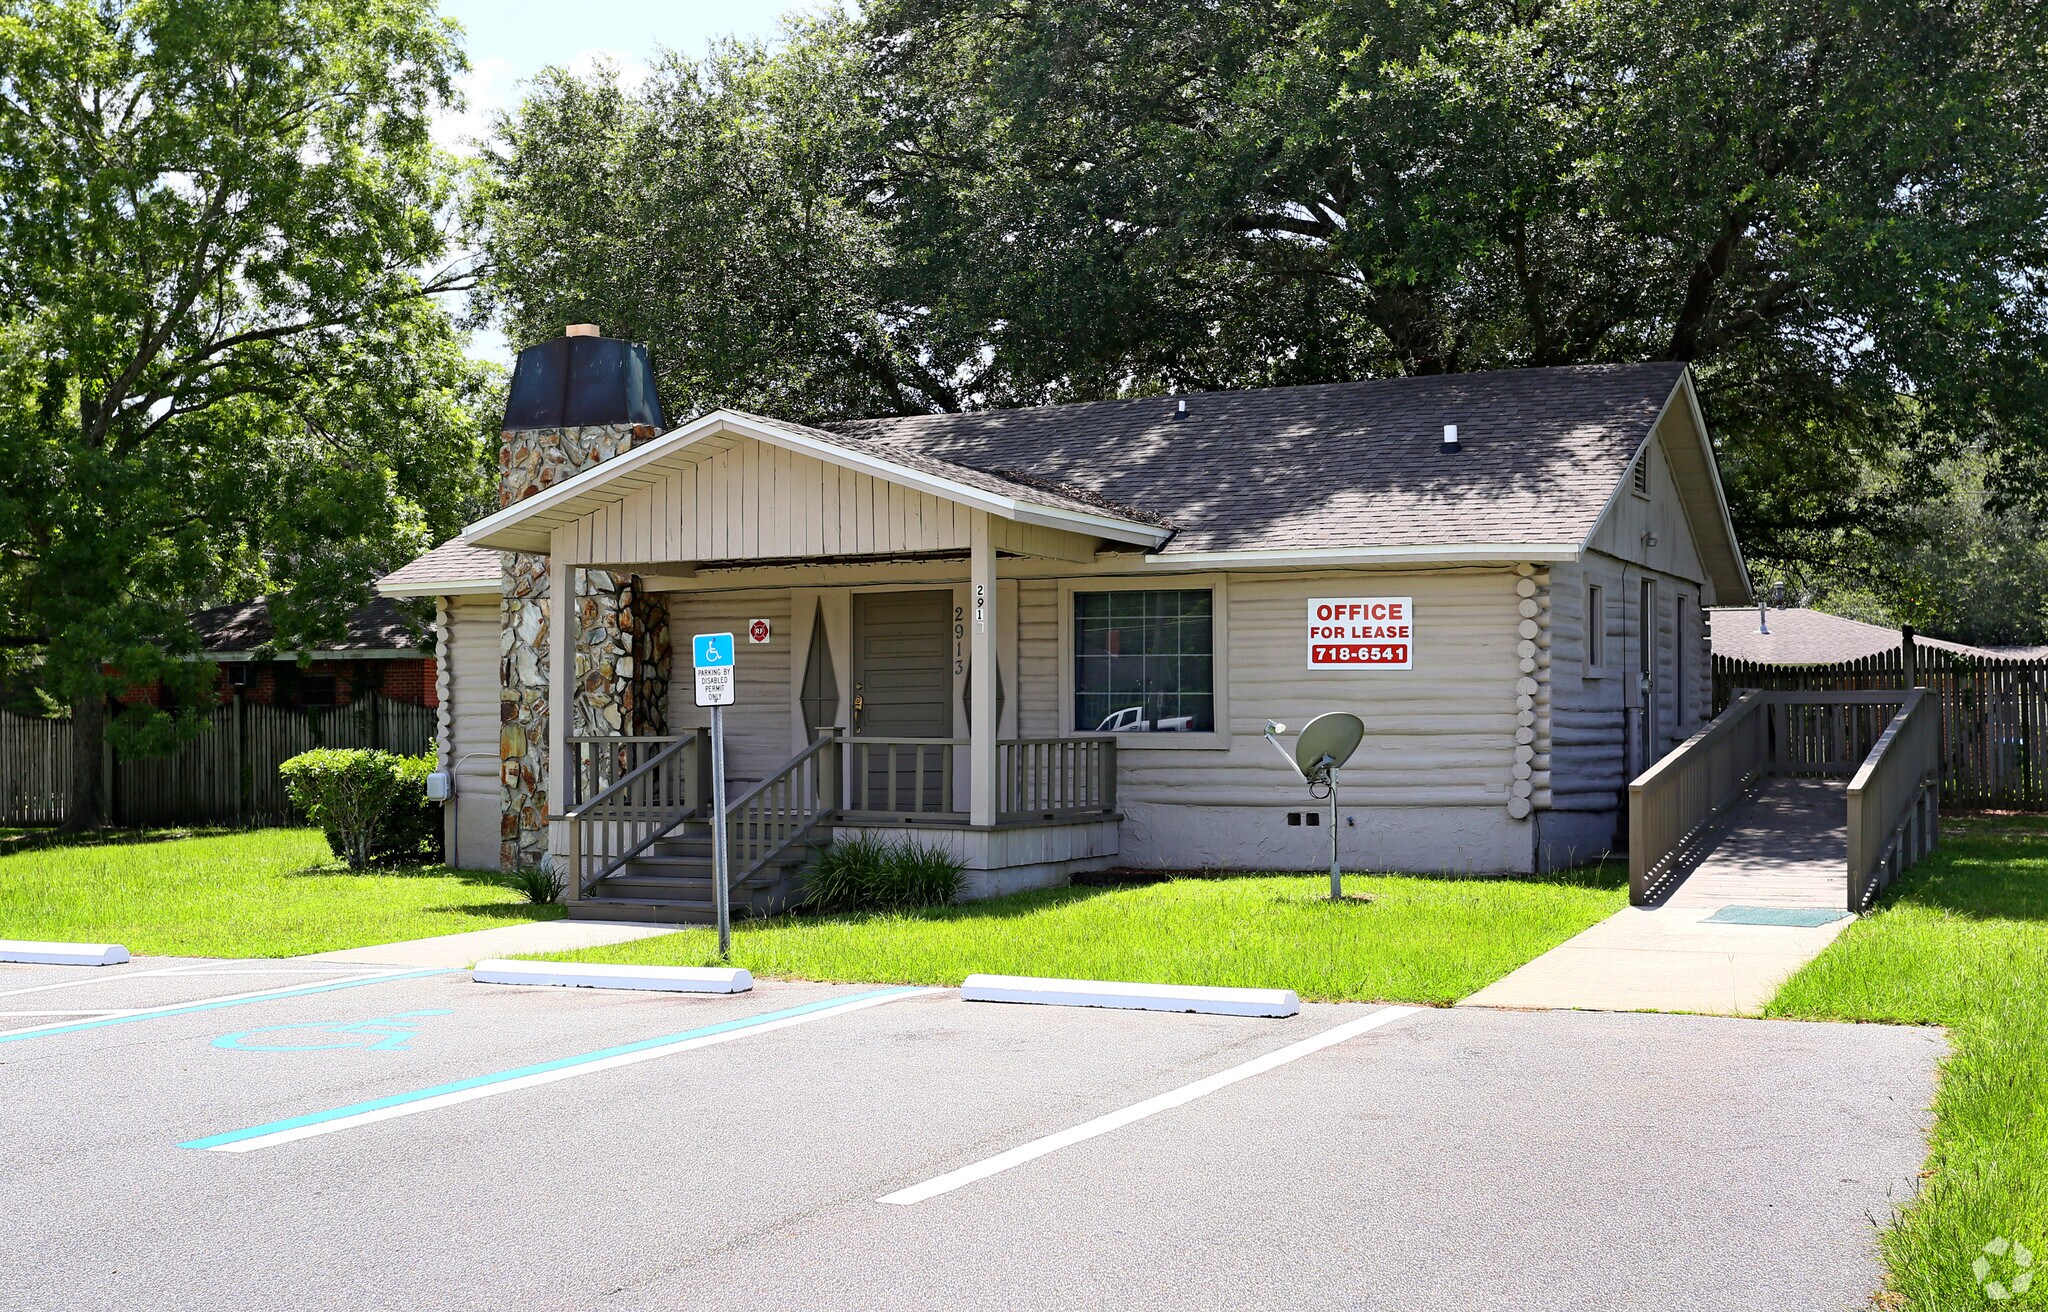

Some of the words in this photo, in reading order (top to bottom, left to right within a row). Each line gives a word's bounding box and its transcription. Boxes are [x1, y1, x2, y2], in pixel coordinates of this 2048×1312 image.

[1316, 604, 1403, 621] OFFICE
[1310, 626, 1345, 639] FOR
[1351, 625, 1410, 639] LEASE
[954, 606, 964, 675] 2913
[1316, 647, 1404, 661] 718-6541
[723, 667, 731, 676] BY
[702, 676, 728, 684] DISABLED
[708, 693, 722, 701] ONLY
